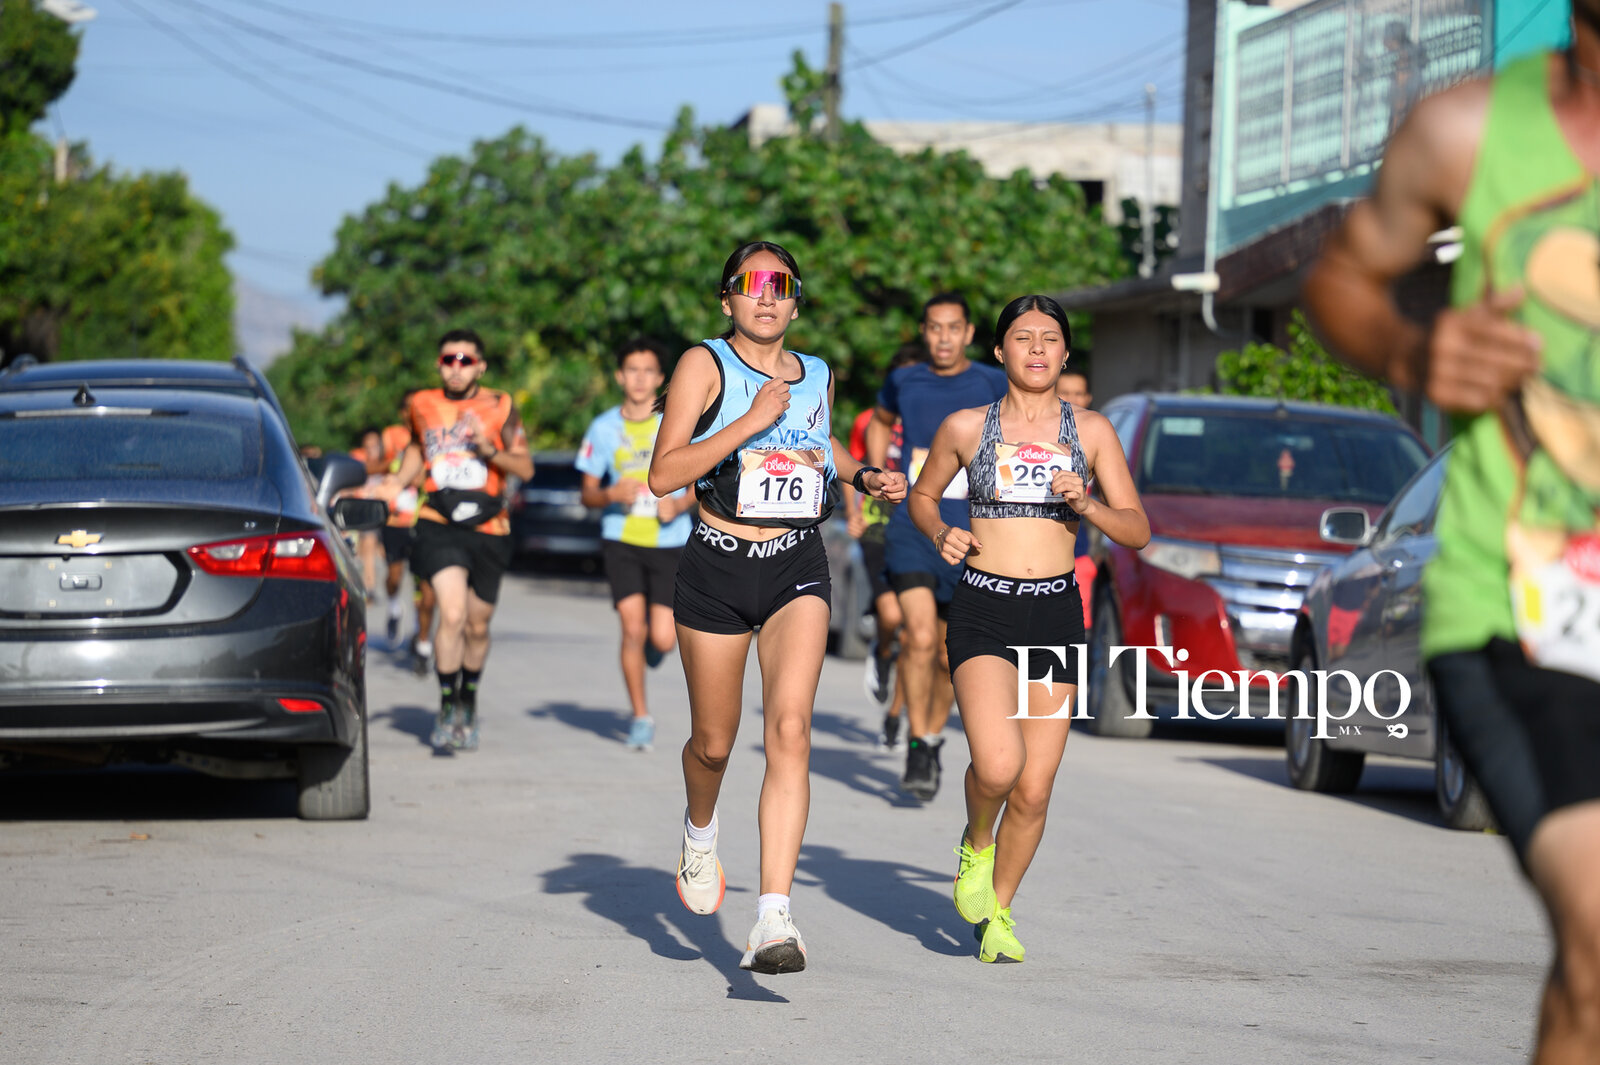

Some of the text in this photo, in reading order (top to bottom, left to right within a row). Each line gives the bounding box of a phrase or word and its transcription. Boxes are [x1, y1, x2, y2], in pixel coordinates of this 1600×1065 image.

[777, 428, 809, 447] VIP
[759, 477, 803, 501] 176
[813, 473, 821, 512] MEDALLA
[695, 521, 739, 552] PRO
[746, 528, 798, 559] NIKE
[962, 569, 1014, 594] NIKE
[1016, 578, 1067, 596] PRO
